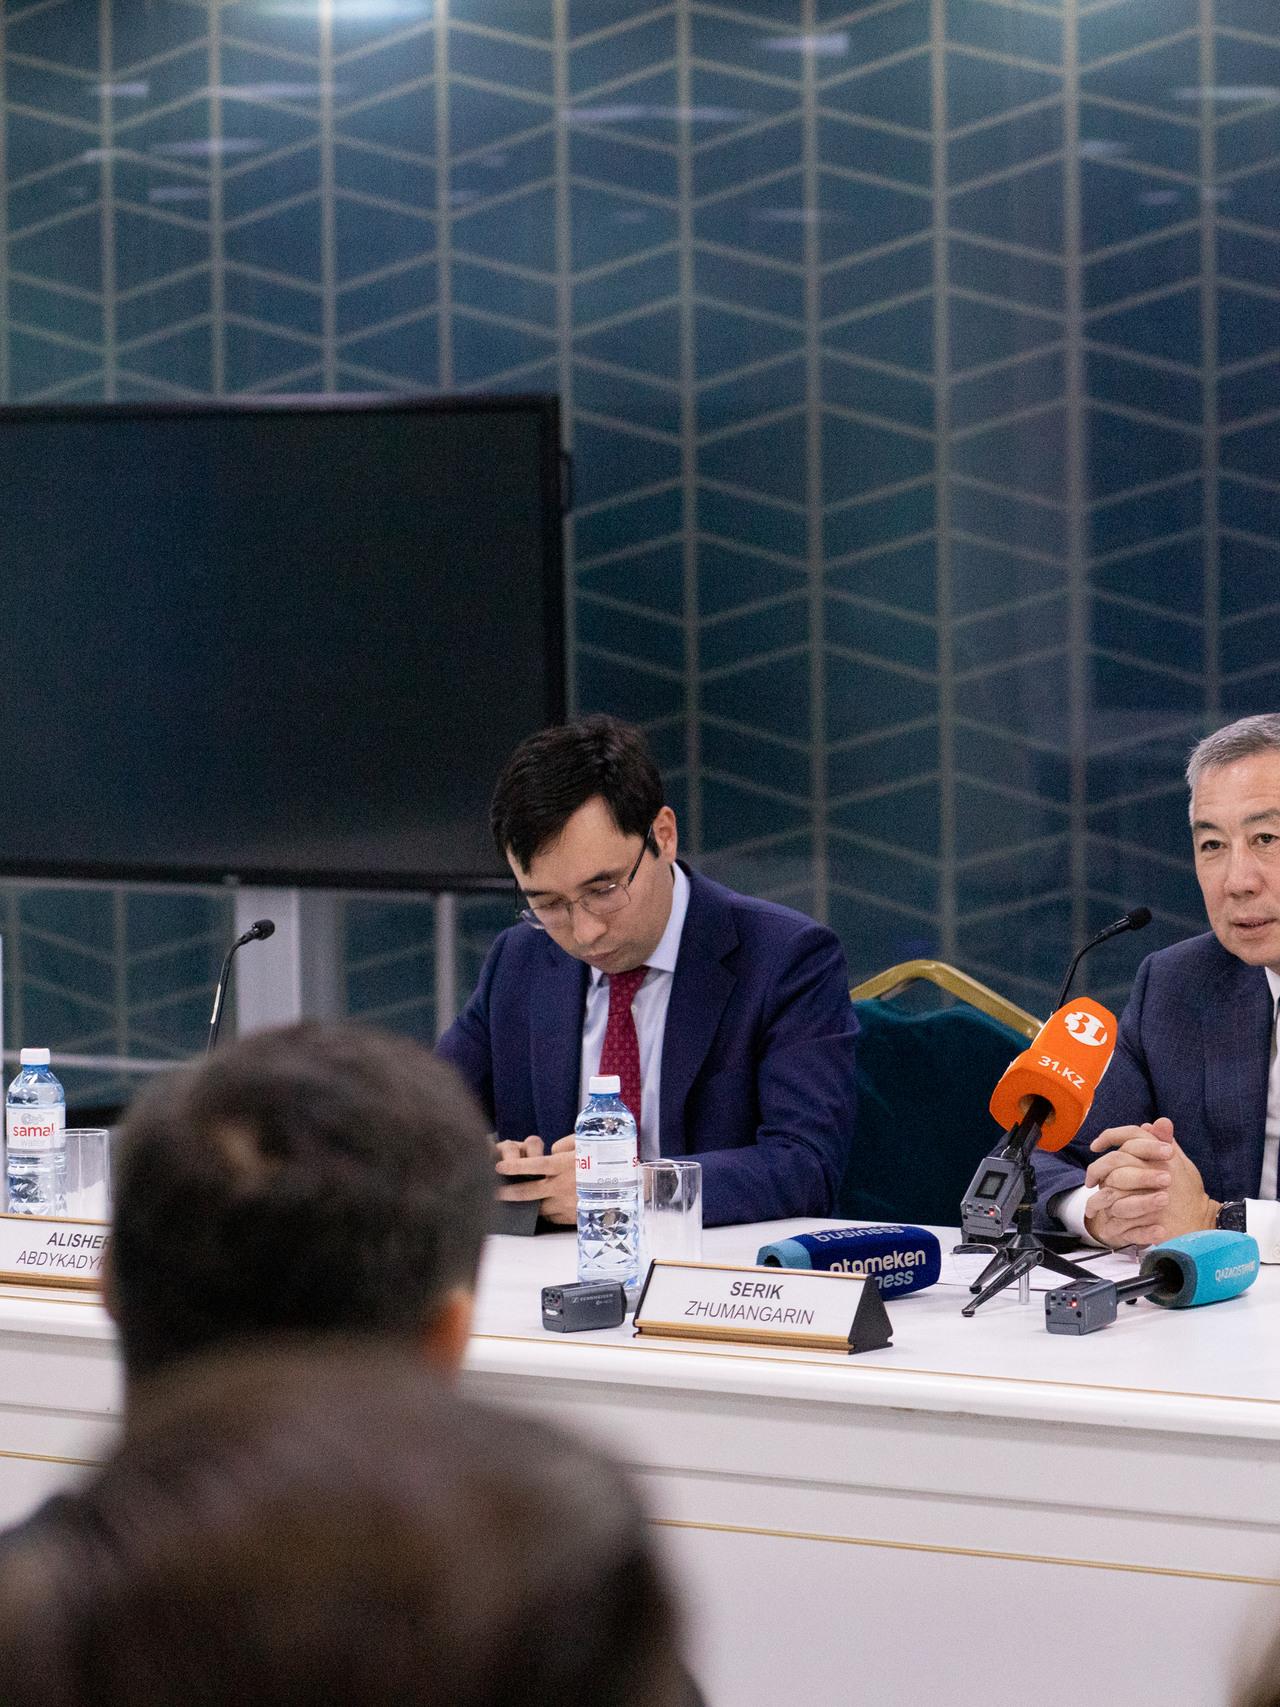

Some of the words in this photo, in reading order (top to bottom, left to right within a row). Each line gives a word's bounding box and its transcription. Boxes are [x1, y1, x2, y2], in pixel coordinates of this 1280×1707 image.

[1038, 1055, 1086, 1090] 31.KZ
[730, 1281, 784, 1300] SERIK
[874, 1270, 915, 1290] ness
[684, 1300, 815, 1325] ZHUMANGARIN
